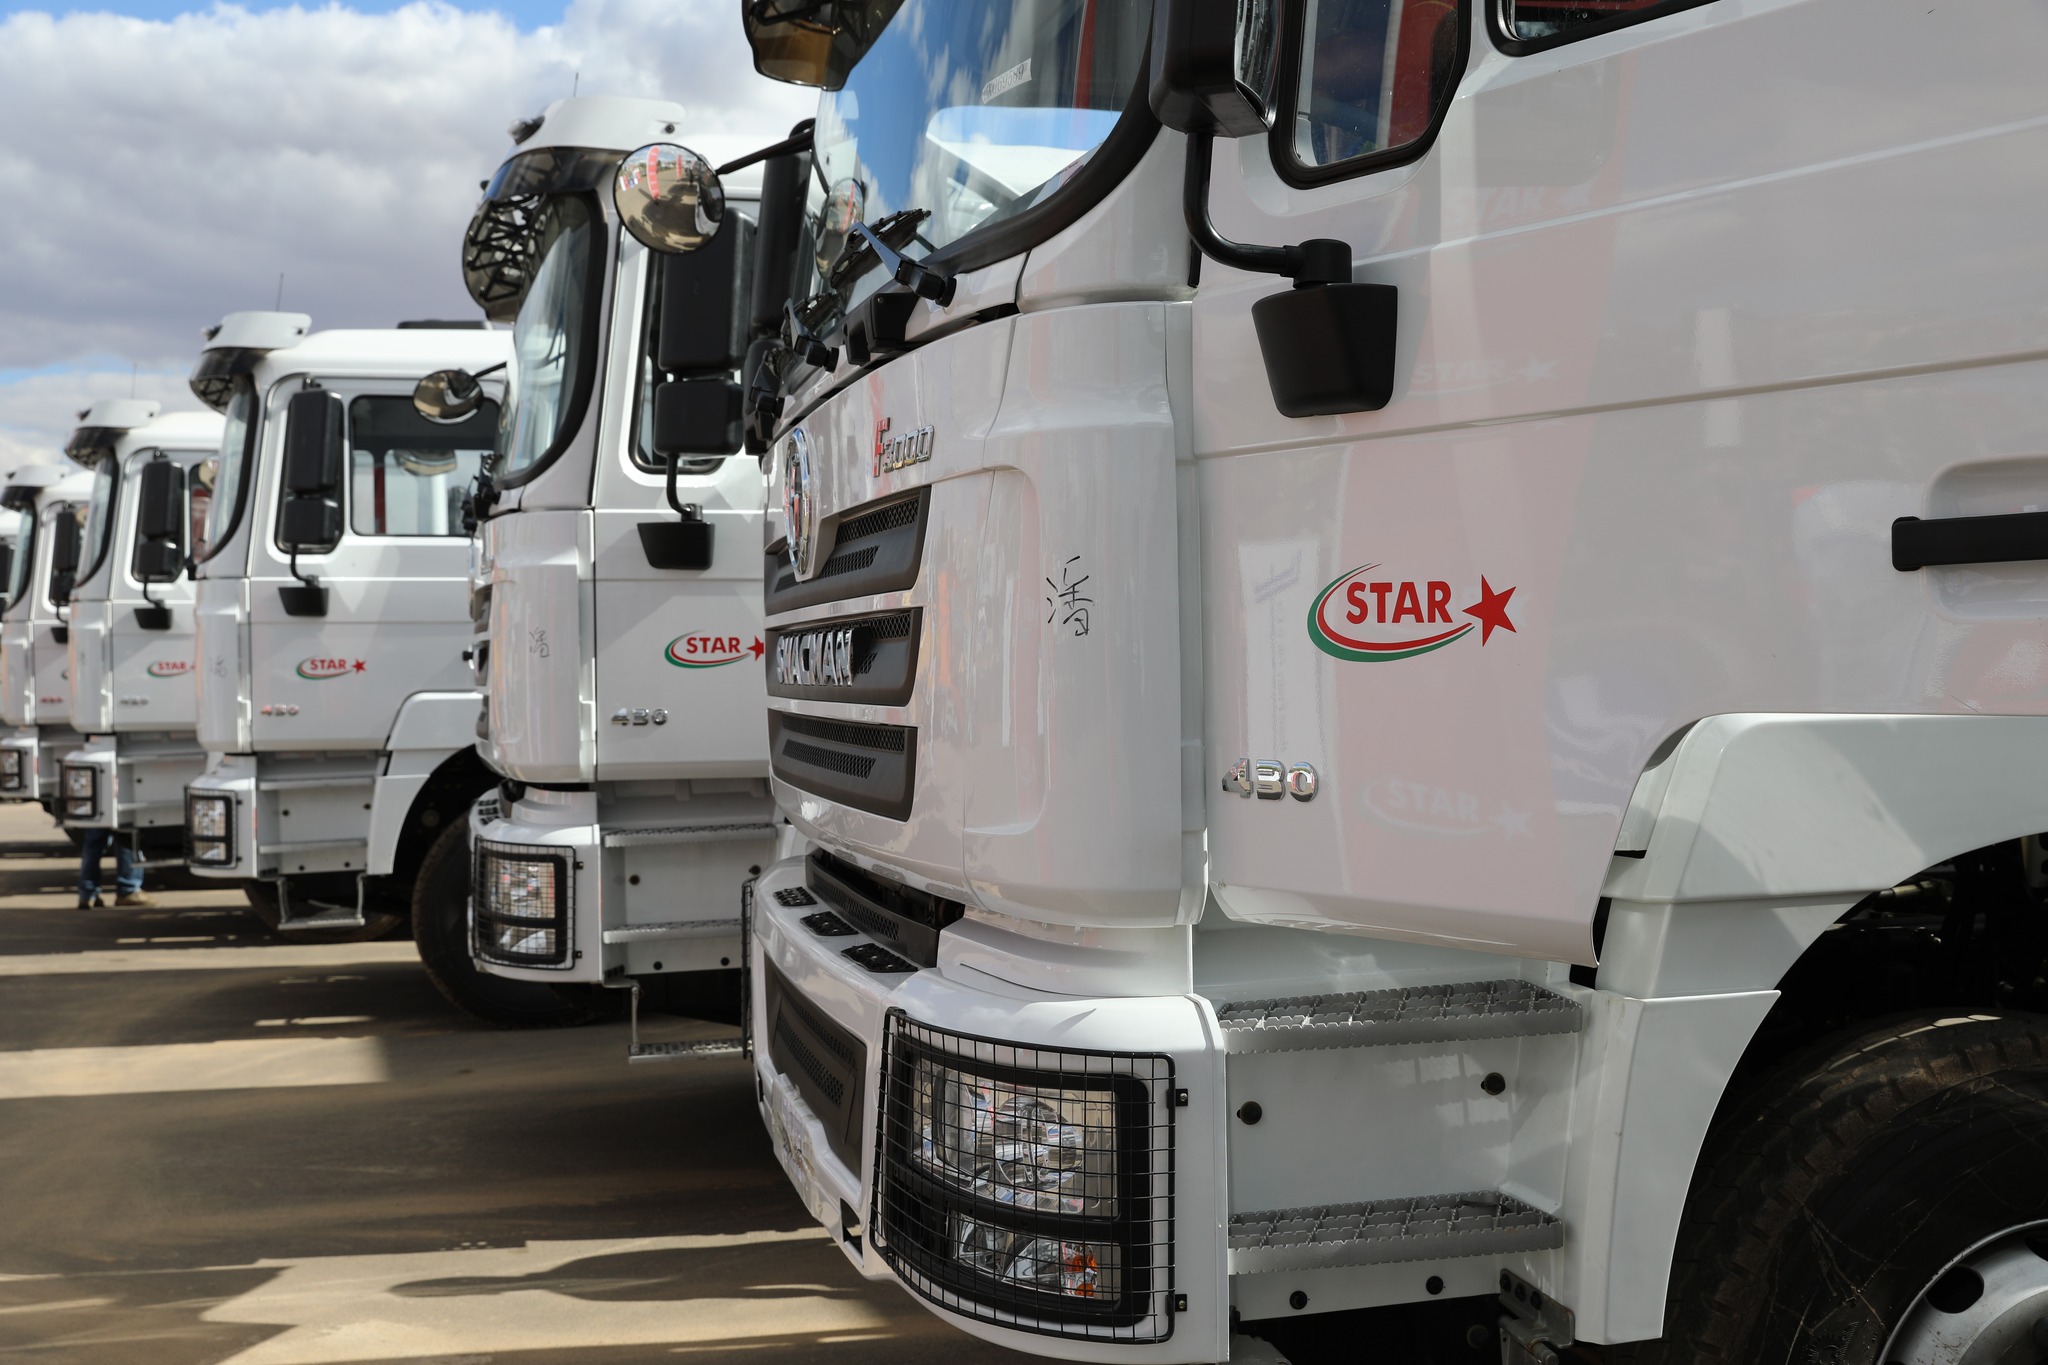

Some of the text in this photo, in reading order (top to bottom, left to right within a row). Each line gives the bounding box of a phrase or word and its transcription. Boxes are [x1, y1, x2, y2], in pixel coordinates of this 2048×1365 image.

[873, 417, 934, 478] F3000
[1345, 580, 1453, 625] STAR
[686, 637, 741, 654] STAR
[157, 661, 187, 671] STAR
[310, 658, 347, 671] STAR
[611, 708, 668, 726] 430
[1222, 757, 1319, 802] 430
